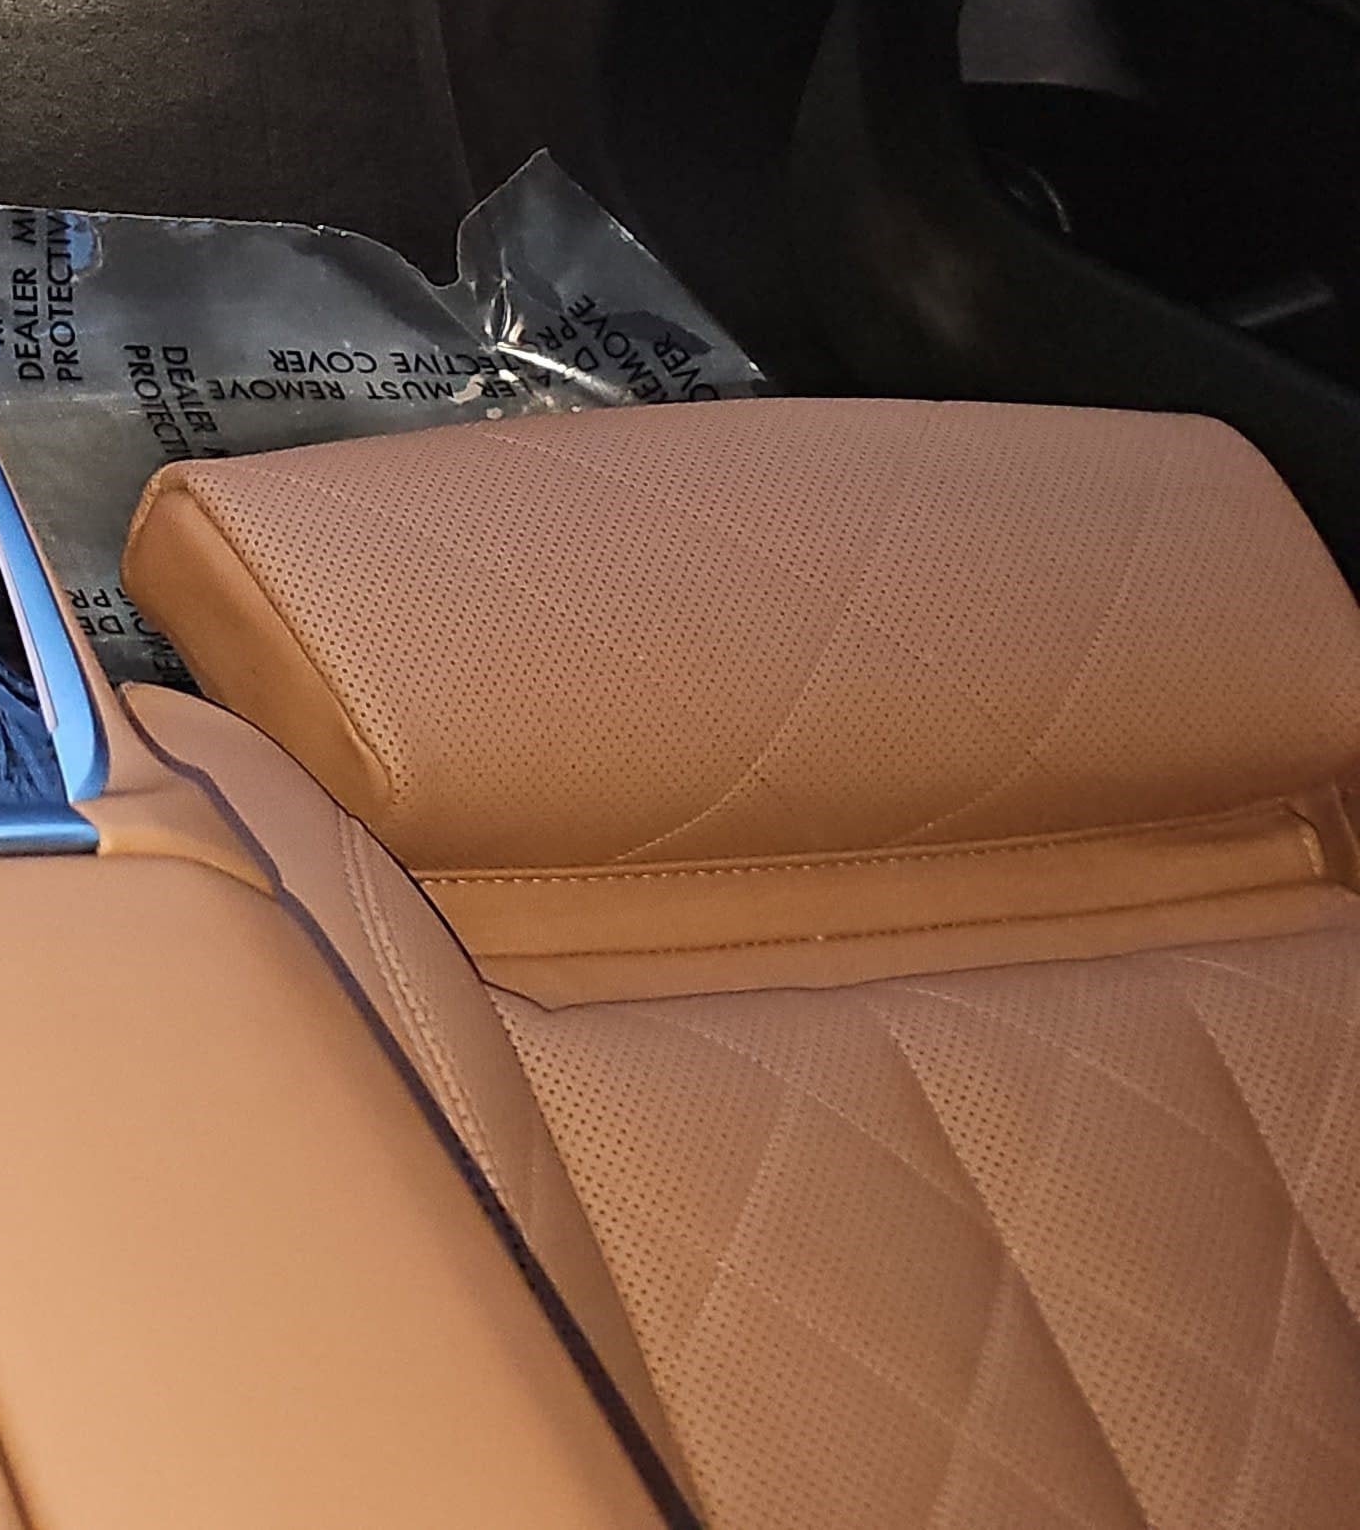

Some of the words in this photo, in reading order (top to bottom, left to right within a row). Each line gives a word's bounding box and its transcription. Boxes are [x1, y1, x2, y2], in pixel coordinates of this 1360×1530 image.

[11, 268, 46, 381] DEALER
[162, 344, 219, 435] DEALER
[207, 378, 346, 403] REMOVE
[270, 349, 377, 374] COVER
[123, 344, 193, 460] PROTECTI
[367, 379, 454, 403] MUST
